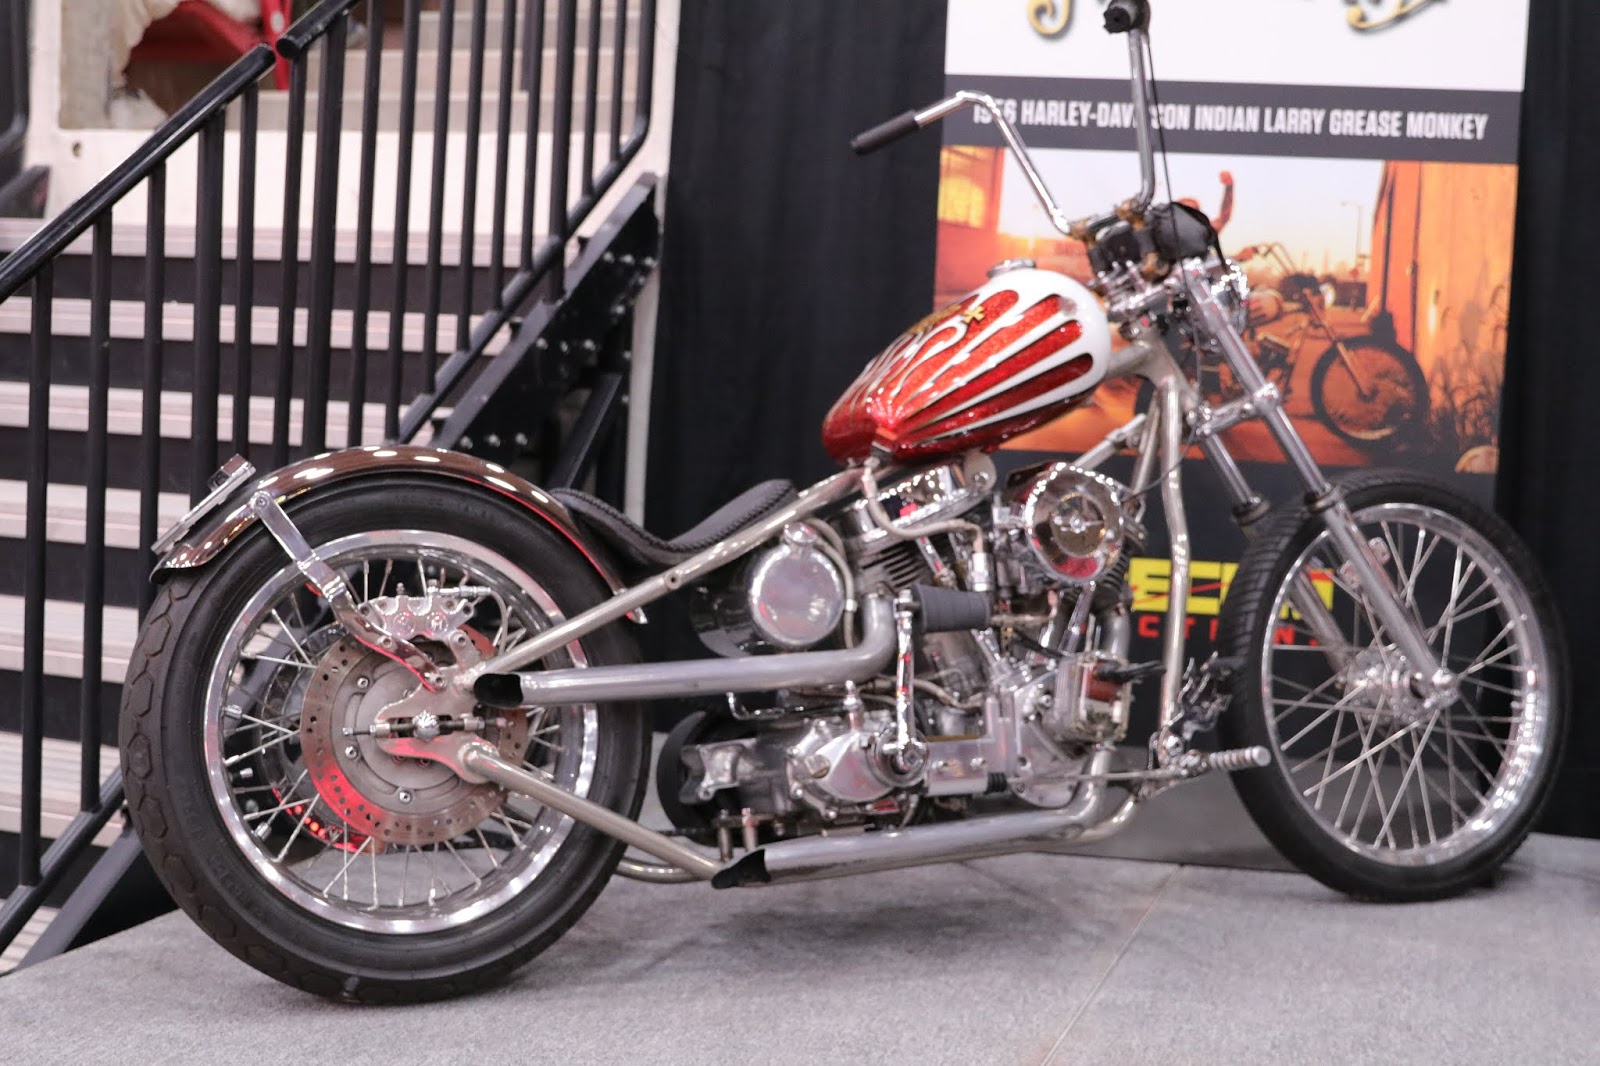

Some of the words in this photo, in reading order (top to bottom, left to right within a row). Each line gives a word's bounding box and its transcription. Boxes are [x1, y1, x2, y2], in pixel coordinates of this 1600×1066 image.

[1021, 99, 1190, 130] HARLEY-DAVSON
[1194, 104, 1260, 132] INDIAN
[1264, 107, 1326, 135] LARRY
[1329, 109, 1403, 138] GREASE
[1406, 112, 1488, 140] MONKEY
